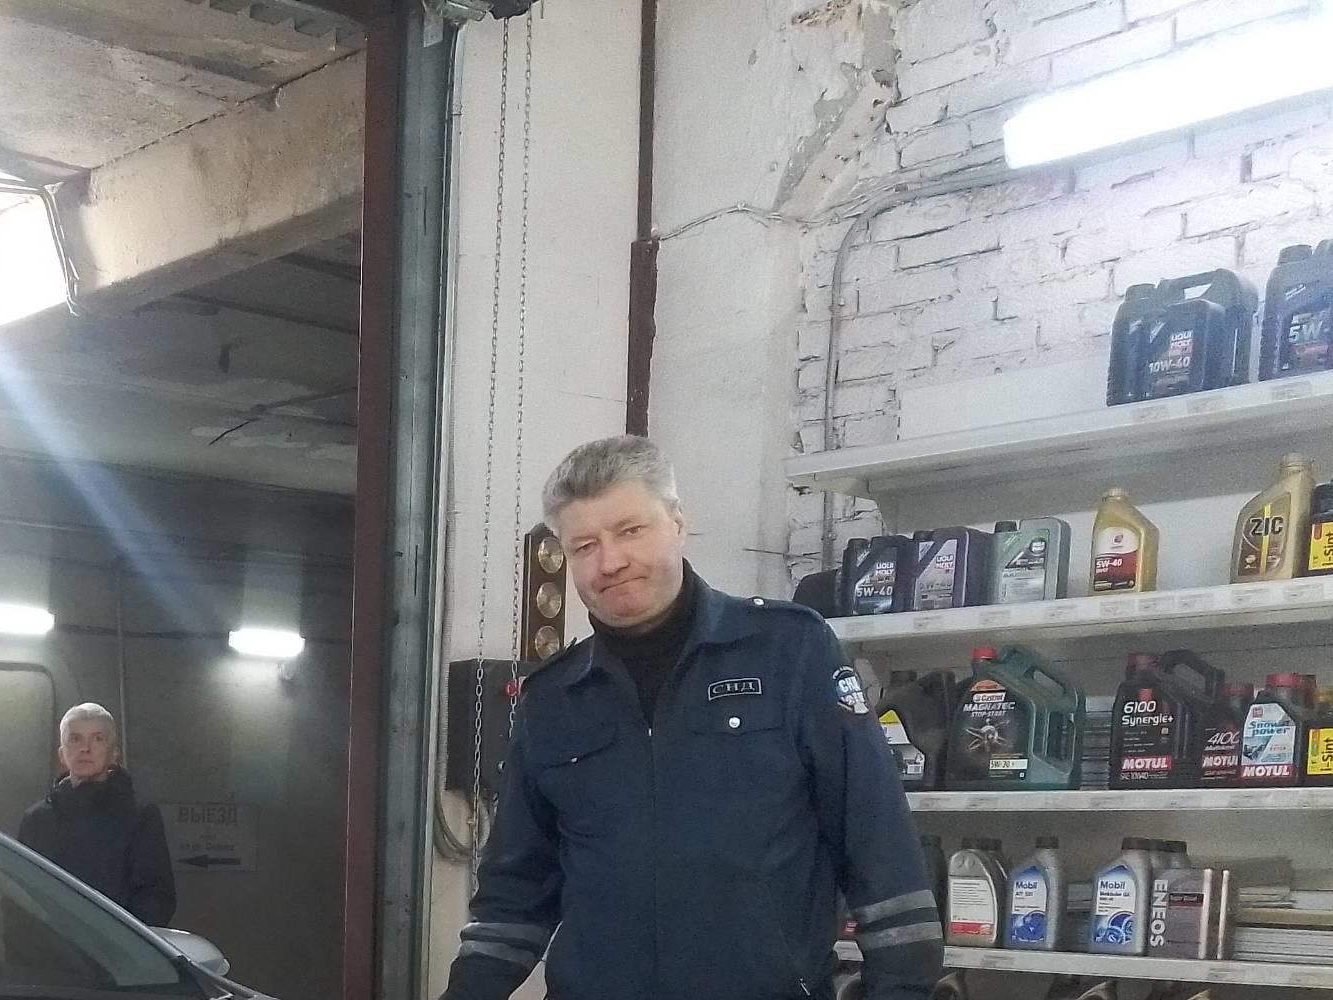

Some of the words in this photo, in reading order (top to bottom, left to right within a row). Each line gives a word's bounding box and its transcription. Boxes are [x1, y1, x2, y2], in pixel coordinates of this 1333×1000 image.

[1171, 330, 1194, 341] LIQUI
[1148, 357, 1191, 374] 10W-40
[1250, 516, 1284, 536] ZIC
[875, 562, 895, 570] LIQUI
[1096, 558, 1123, 570] 5W-40
[856, 586, 893, 597] 5W-40
[712, 682, 755, 695] СНД
[963, 702, 1016, 712] MAGNATEC
[1123, 701, 1157, 713] 6100
[1122, 713, 1174, 727] Synergie+
[1252, 727, 1291, 736] power
[1122, 757, 1169, 770] MOTUL
[1242, 765, 1290, 777] MOTUL
[178, 806, 238, 826] ВЫЕЗД
[1015, 882, 1038, 890] Mobil
[1100, 881, 1126, 889] Mobil
[1150, 880, 1168, 947] ENEOS
